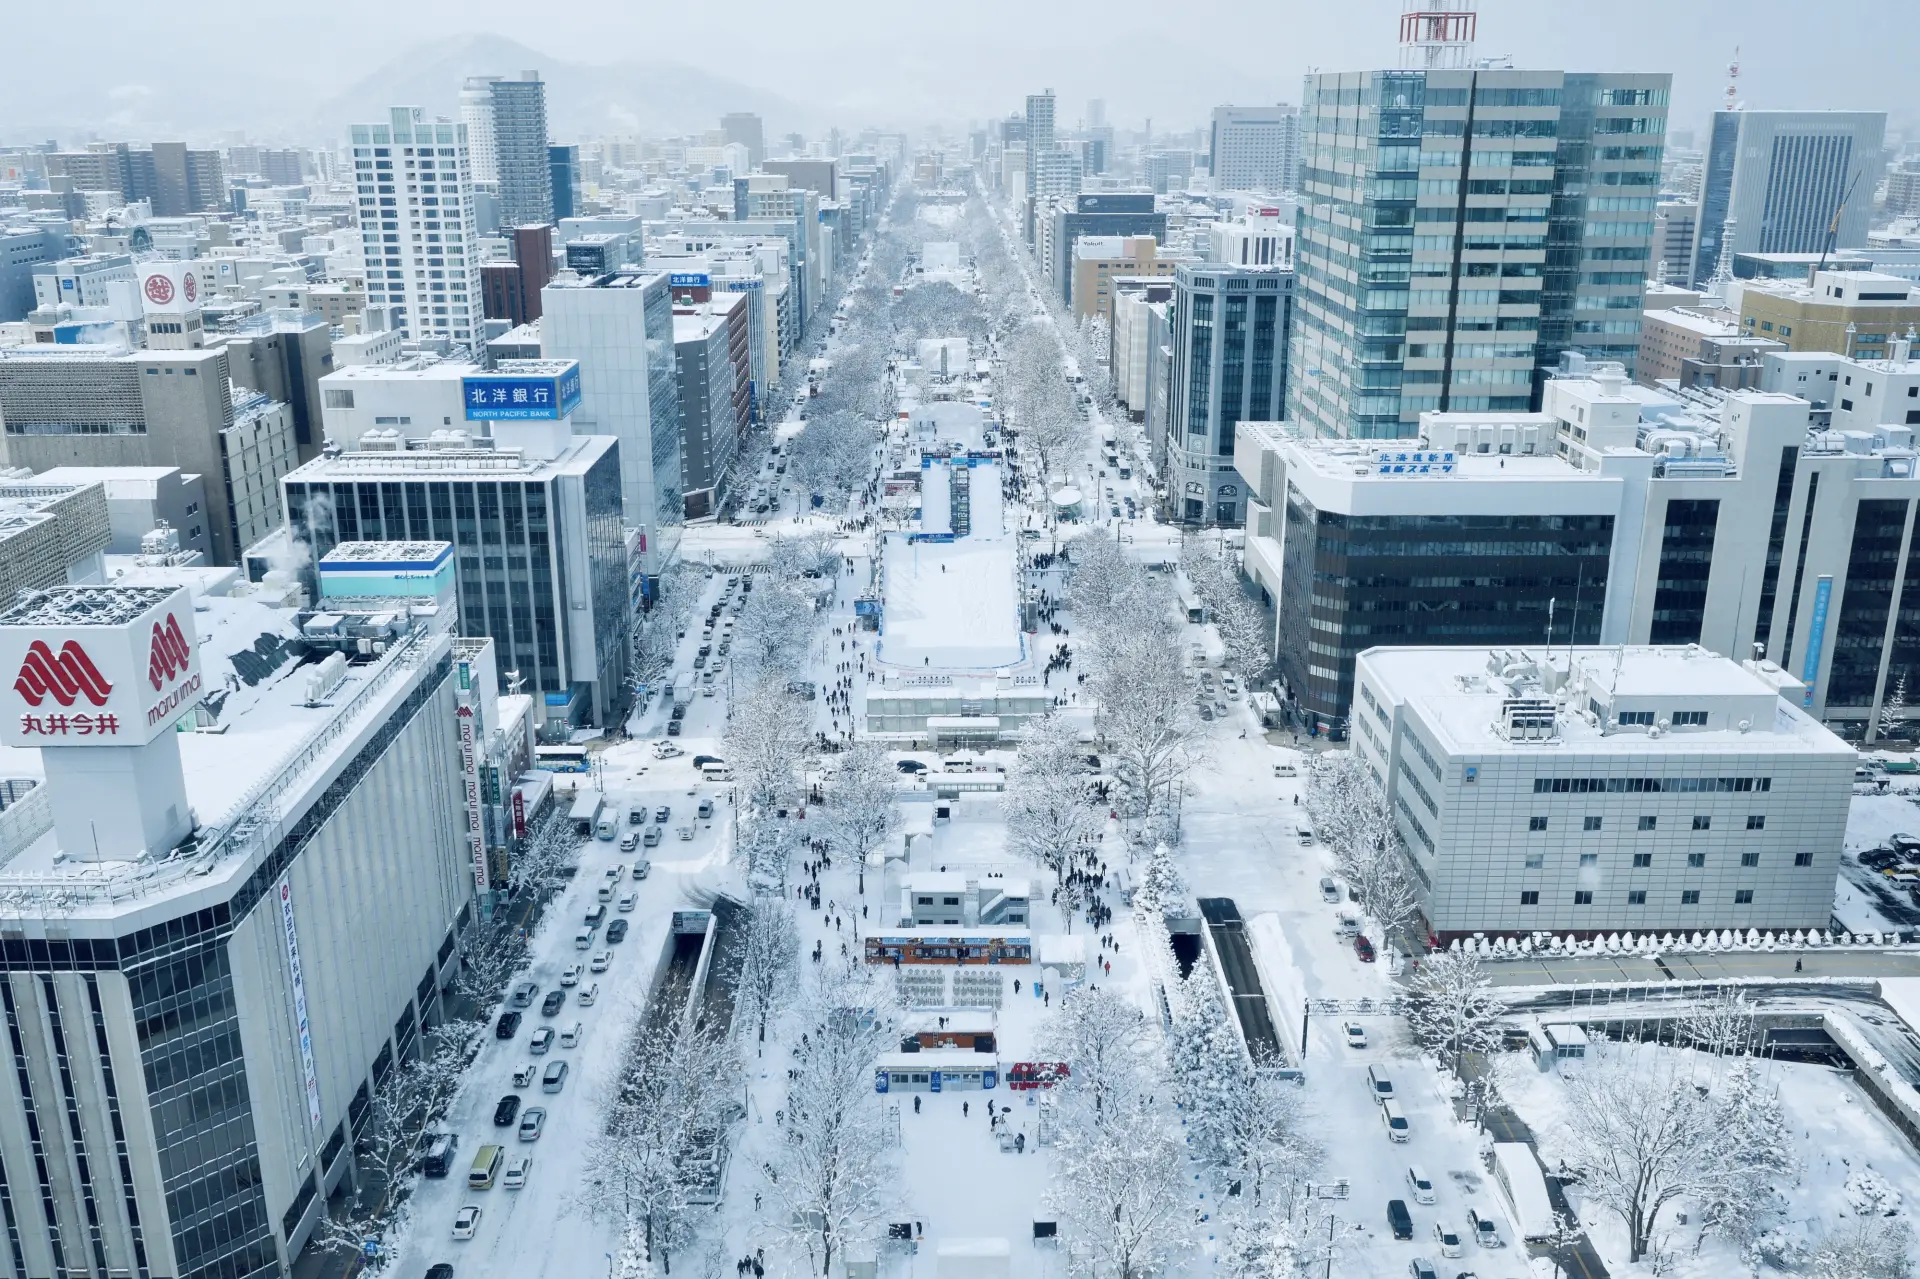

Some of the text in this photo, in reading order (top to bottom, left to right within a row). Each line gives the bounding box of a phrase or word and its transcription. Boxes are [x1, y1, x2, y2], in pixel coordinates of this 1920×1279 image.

[221, 265, 229, 273] P
[673, 276, 701, 284] 北洋銀行
[472, 388, 549, 403] 北洋銀行
[148, 673, 201, 727] marui imai
[20, 713, 119, 735] 丸井今井
[462, 724, 474, 775] marui imai
[468, 781, 477, 810] marui
[473, 837, 484, 886] marui imai
